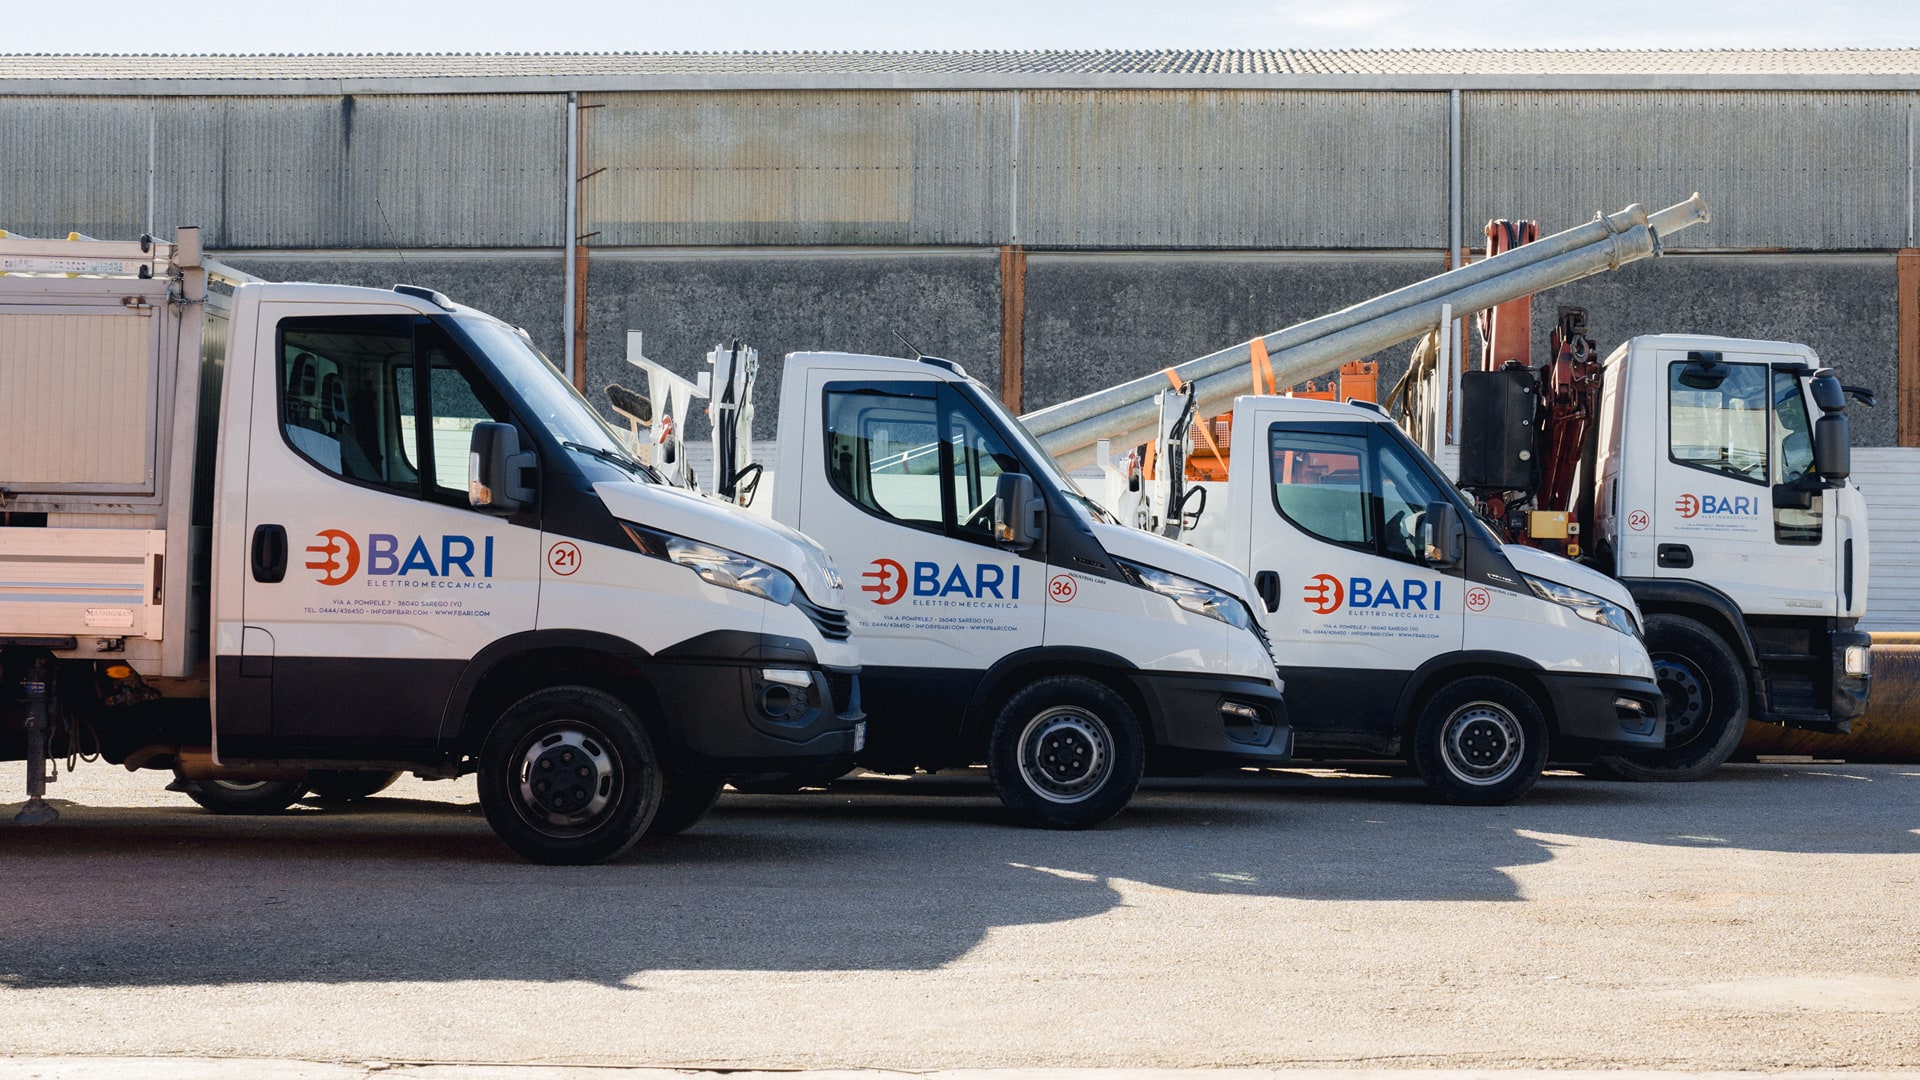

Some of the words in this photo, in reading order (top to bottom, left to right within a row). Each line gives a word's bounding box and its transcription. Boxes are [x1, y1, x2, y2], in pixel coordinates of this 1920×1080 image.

[1702, 495, 1758, 515] BARI
[1631, 515, 1647, 525] 24
[367, 533, 494, 578] BARI
[555, 549, 575, 566] 21
[367, 579, 493, 589] ELETTROMECCANICA
[913, 561, 1020, 600] BARI
[1052, 581, 1072, 596] 36
[1349, 577, 1441, 611] BARI
[912, 599, 1019, 609] ELETTROMECCANICA
[1469, 593, 1485, 606] 35
[1348, 610, 1440, 619] ELETTROMECCANICA
